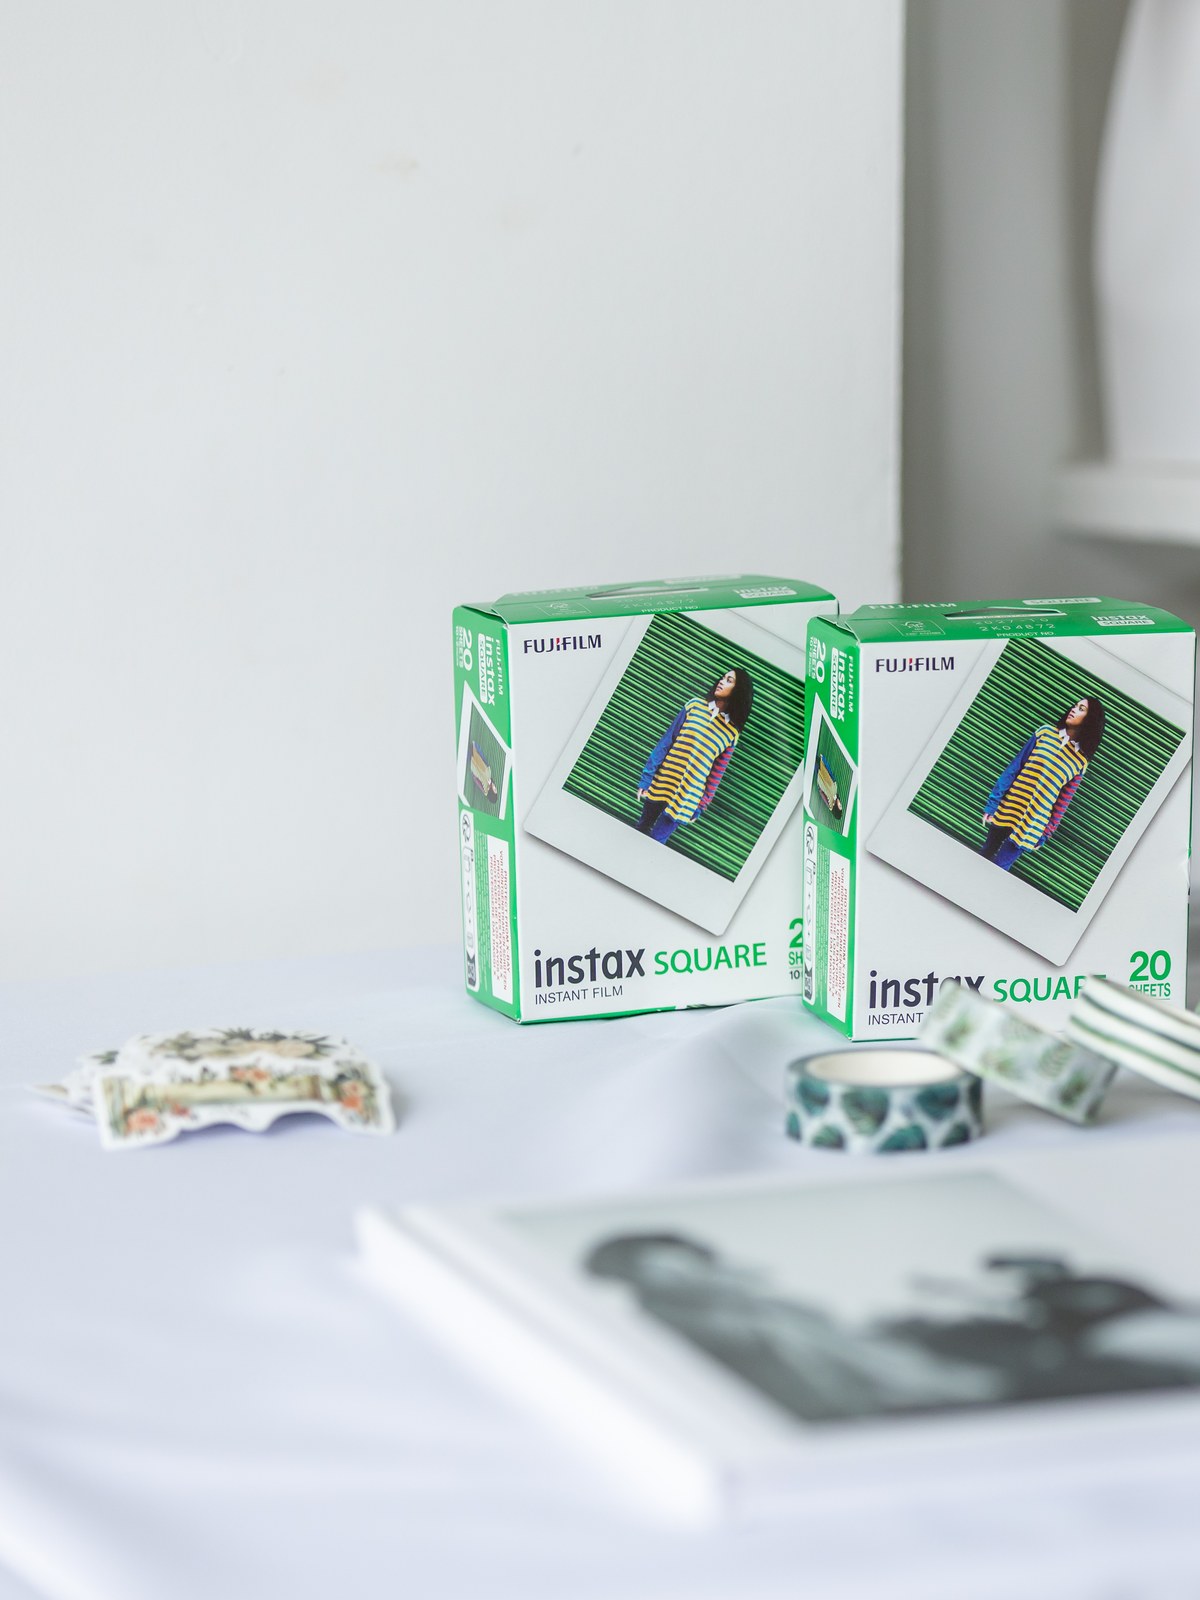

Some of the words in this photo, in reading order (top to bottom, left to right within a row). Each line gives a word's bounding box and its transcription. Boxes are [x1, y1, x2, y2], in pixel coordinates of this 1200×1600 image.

[463, 627, 473, 671] 20
[523, 634, 602, 654] FUJIFILM
[485, 635, 496, 707] instax
[815, 639, 826, 684] 20
[875, 656, 955, 673] FUJIFILM
[837, 650, 848, 722] instax
[789, 918, 803, 948] 2
[534, 946, 646, 988] instax
[654, 942, 767, 975] SQUARE
[1129, 949, 1172, 982] 20
[535, 988, 589, 1005] INSTANT
[593, 984, 624, 998] FILM
[868, 1012, 924, 1026] INSTANT
